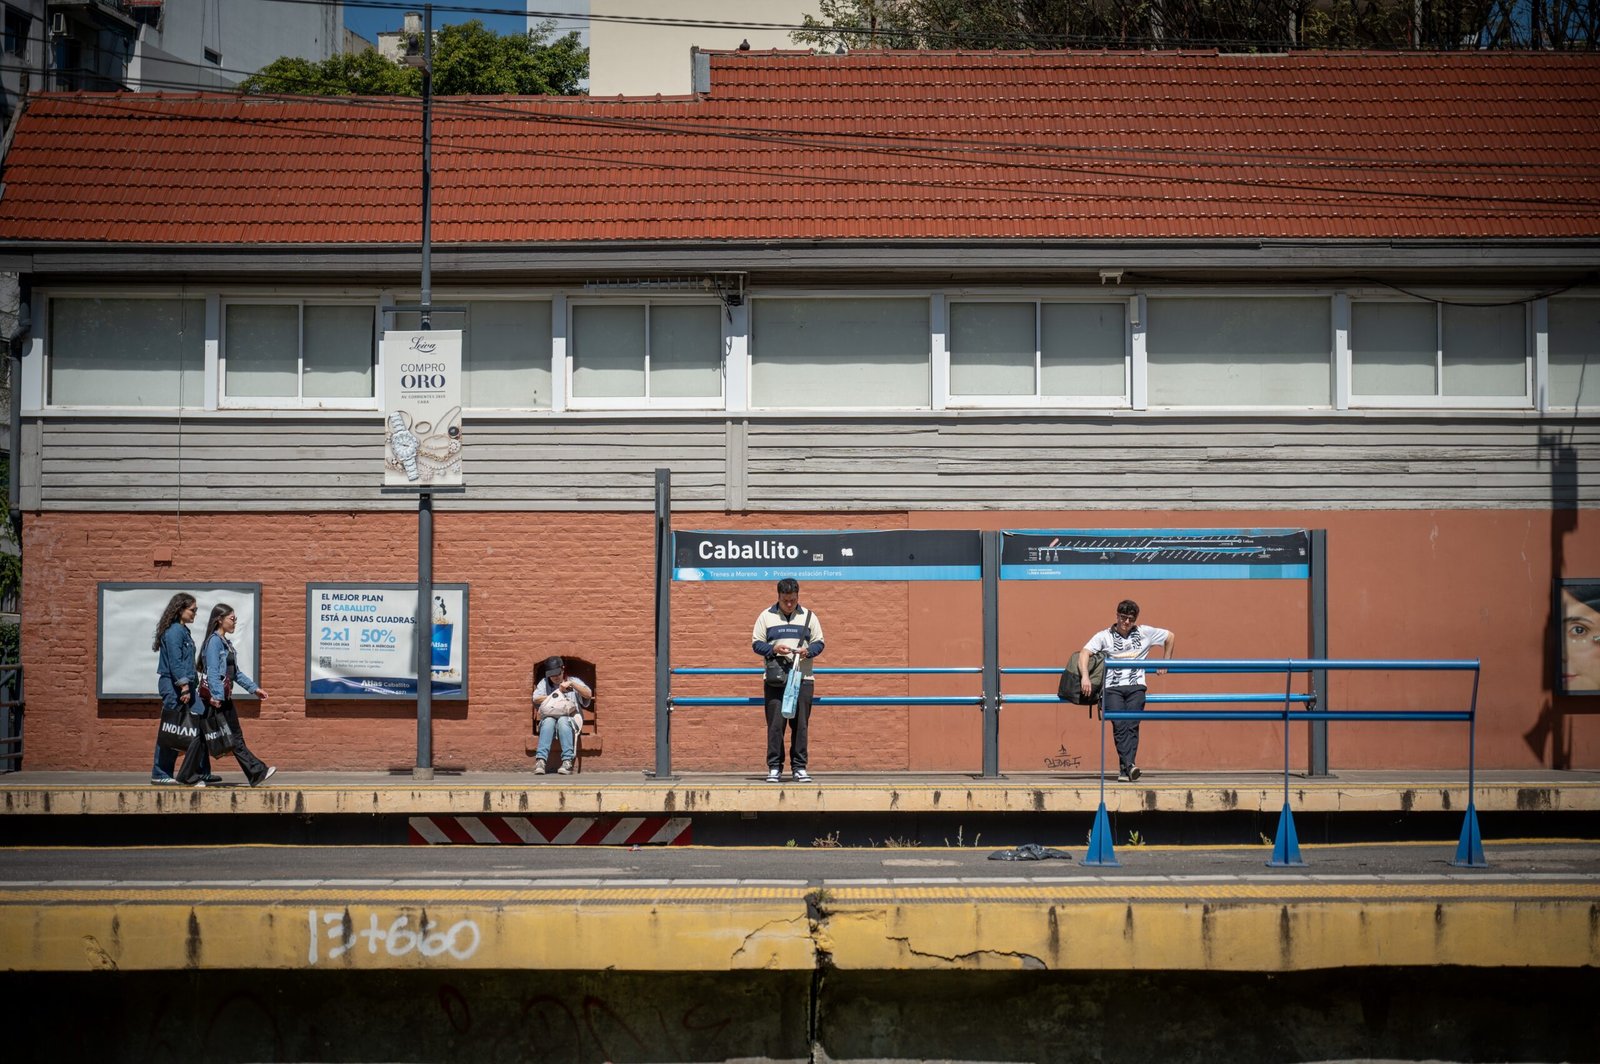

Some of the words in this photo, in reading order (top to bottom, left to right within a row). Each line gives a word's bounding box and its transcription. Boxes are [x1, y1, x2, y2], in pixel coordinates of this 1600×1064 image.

[409, 336, 437, 353] Leiva
[400, 363, 446, 372] COMPRO
[400, 374, 446, 388] ORO
[698, 540, 799, 559] Caballito
[362, 594, 384, 602] PLAN
[334, 604, 377, 612] CABALLITO
[320, 613, 339, 622] ESTÁ
[350, 615, 374, 623] UNAS
[321, 627, 350, 641] 2x1
[360, 629, 396, 643] 50%
[162, 722, 197, 737] INDIAN
